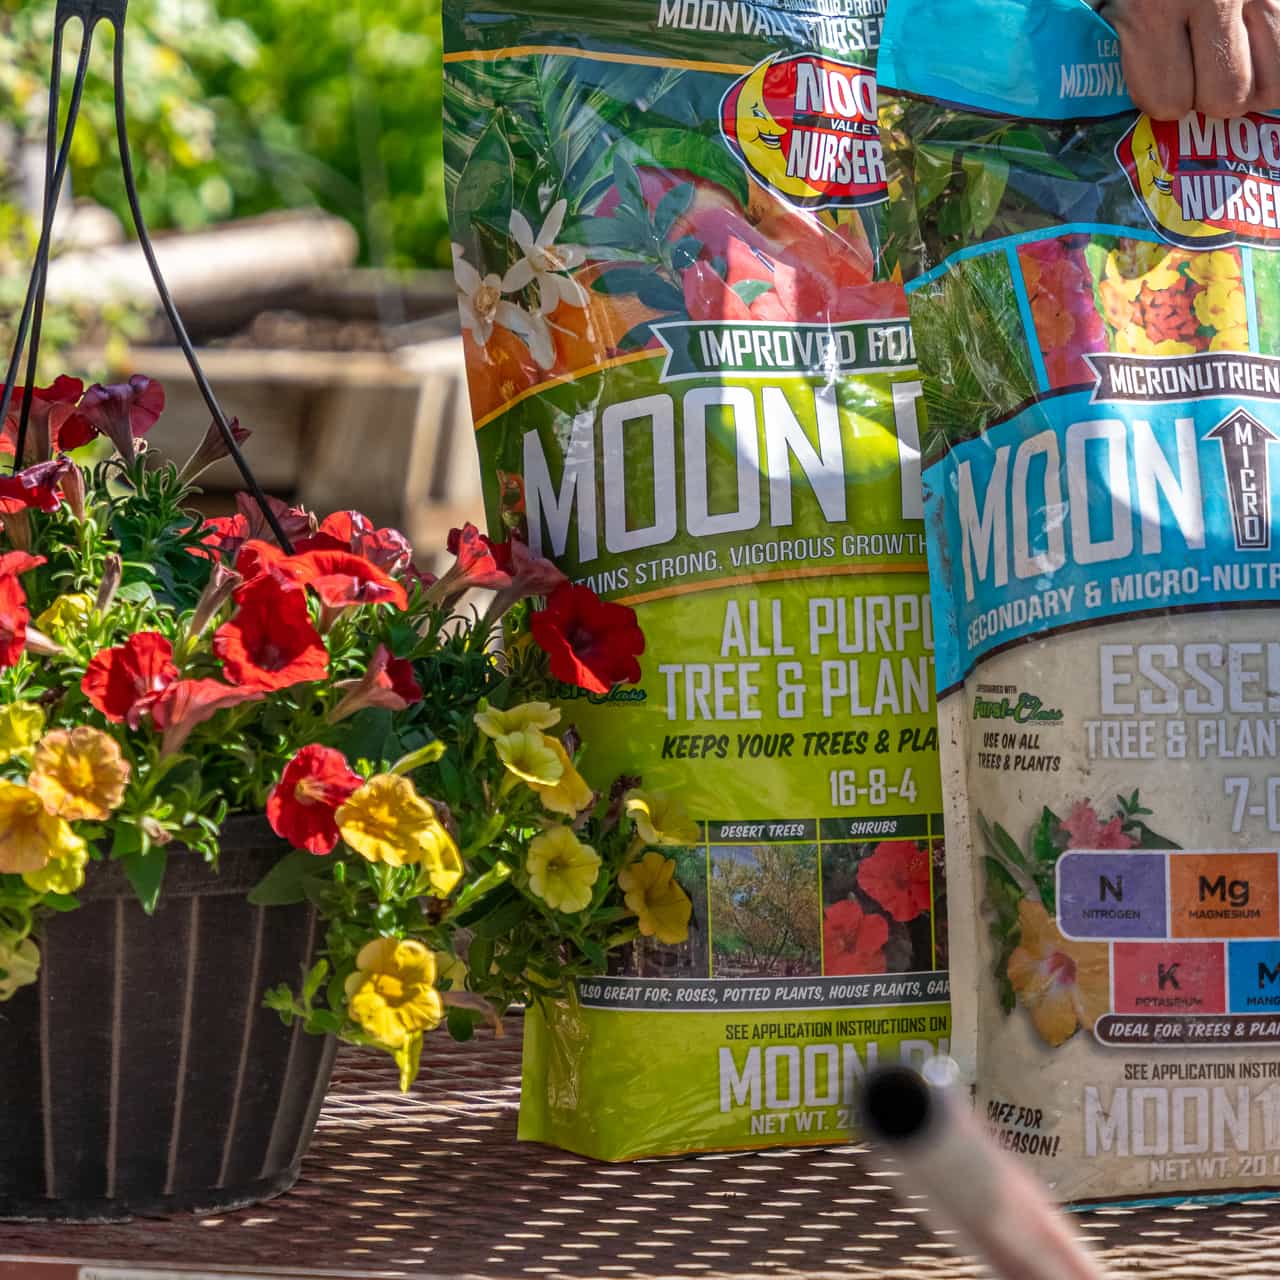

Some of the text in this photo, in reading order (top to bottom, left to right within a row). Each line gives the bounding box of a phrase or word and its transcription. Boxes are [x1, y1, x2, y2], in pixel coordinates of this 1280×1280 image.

[699, 329, 857, 366] IMPROVED
[523, 384, 847, 563] MOON
[1234, 422, 1260, 540] MICRO
[958, 417, 1207, 603] MOON
[729, 536, 835, 568] VIGOROUS
[721, 599, 795, 656] ALL
[967, 583, 1075, 651] SECONDARY
[1084, 581, 1103, 608] &
[658, 662, 761, 721] TREE
[777, 662, 807, 719] &
[661, 734, 730, 760] KEEPS
[737, 732, 796, 758] YOUR
[805, 730, 868, 755] TREES
[874, 730, 890, 753] &
[983, 731, 1040, 750] USE ON ALL
[1086, 719, 1156, 759] TREE
[1166, 719, 1187, 759] &
[978, 751, 1062, 772] TREES & PLANTS
[829, 767, 917, 807] 16-8-4
[720, 823, 804, 838] DESERT TREES
[850, 821, 897, 835] SHRUBS
[1099, 875, 1123, 901] N
[1199, 875, 1249, 906] Mg
[1082, 908, 1141, 919] NITROGEN
[1189, 908, 1261, 919] MAGNESIUM
[1157, 963, 1181, 990] K
[603, 983, 642, 1001] GREAT
[644, 985, 671, 1002] FOR:
[676, 985, 719, 1004] ROSES,
[723, 986, 770, 1002] POTTED
[774, 985, 824, 1002] PLANTS,
[829, 982, 869, 998] HOUSE
[873, 979, 923, 998] PLANTS,
[726, 1015, 947, 1040] SEE APPLICATION INSTRUCTIONS ON
[1109, 1023, 1149, 1037] IDEAL
[1153, 1023, 1182, 1037] FOR
[1188, 1022, 1232, 1037] TREES
[1233, 1022, 1245, 1036] &
[1124, 1063, 1148, 1080] SEE
[1151, 1063, 1236, 1081] APPLICATION
[751, 1112, 789, 1135] NET
[794, 1110, 830, 1132] WT.
[1015, 1106, 1043, 1128] FOR
[1085, 1086, 1250, 1158] MOON
[1150, 1158, 1189, 1182] NET
[1238, 1155, 1266, 1177] 20
